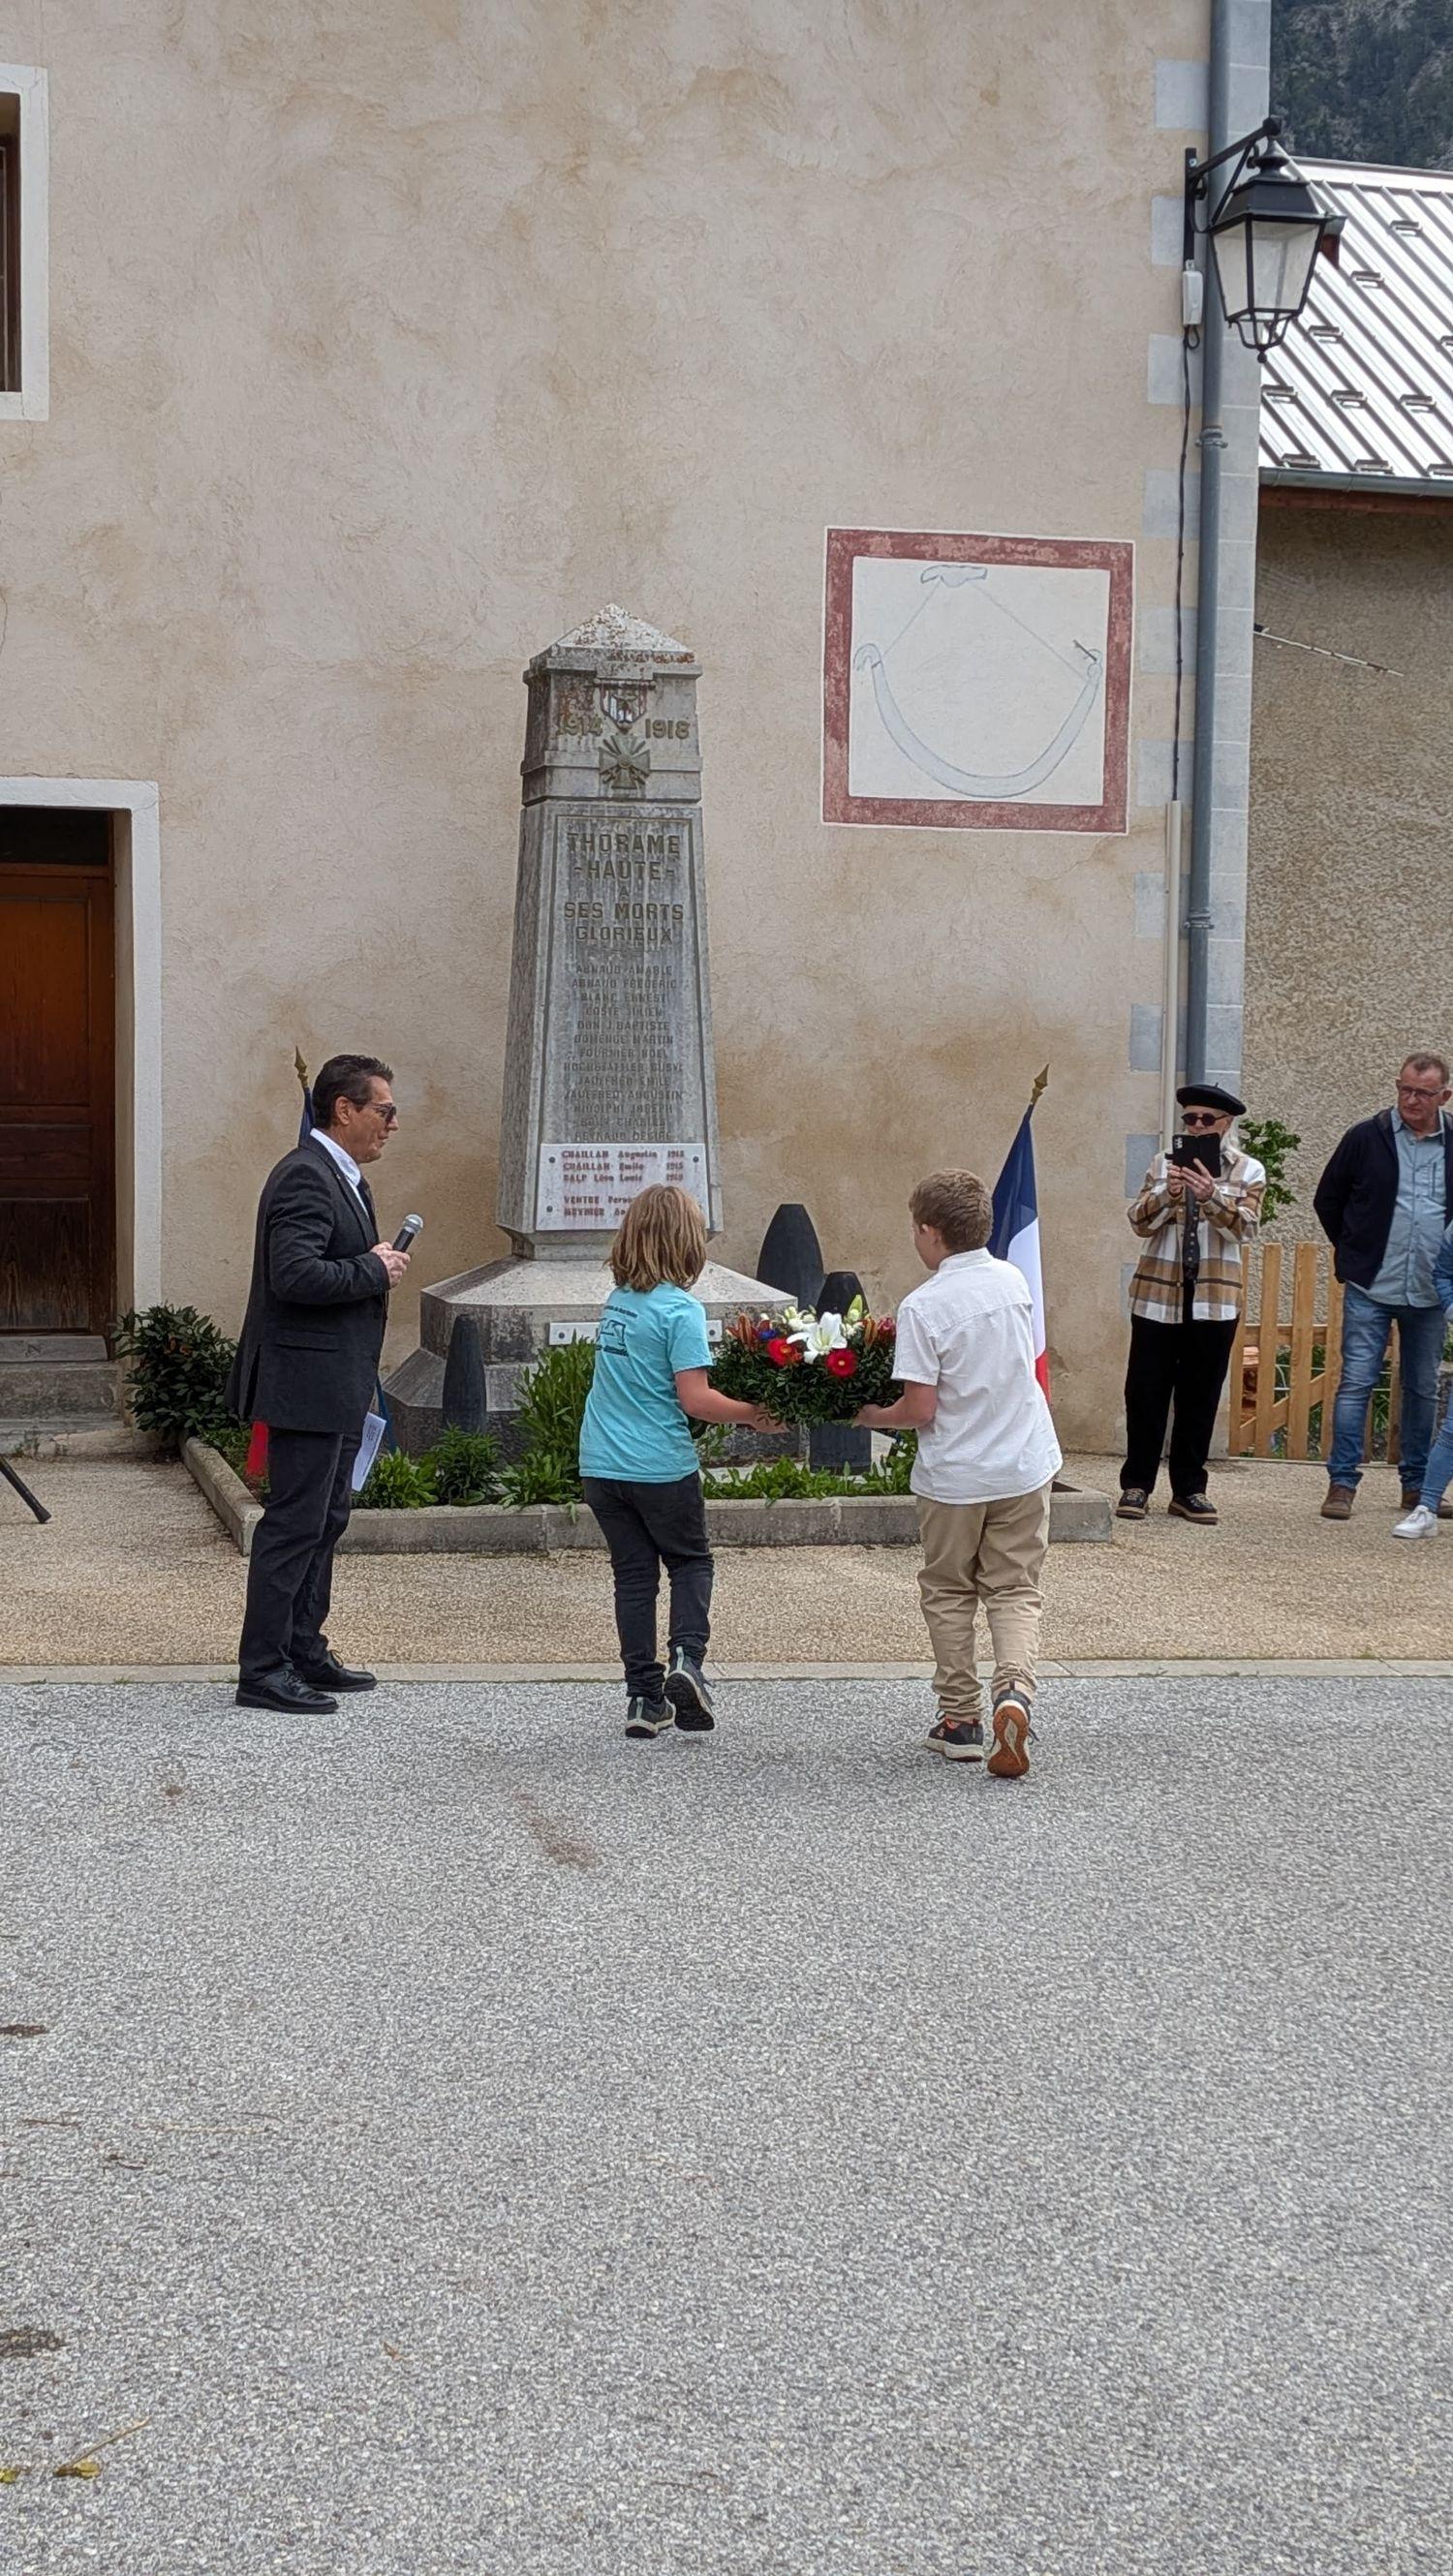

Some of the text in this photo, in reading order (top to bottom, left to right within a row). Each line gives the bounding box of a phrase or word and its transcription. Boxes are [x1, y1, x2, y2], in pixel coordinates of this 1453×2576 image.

[556, 716, 603, 737] 1914
[645, 719, 691, 739] 1918
[567, 833, 680, 854] THORAME
[564, 902, 684, 921] SES MORTS
[575, 926, 673, 944] GLORIEUX
